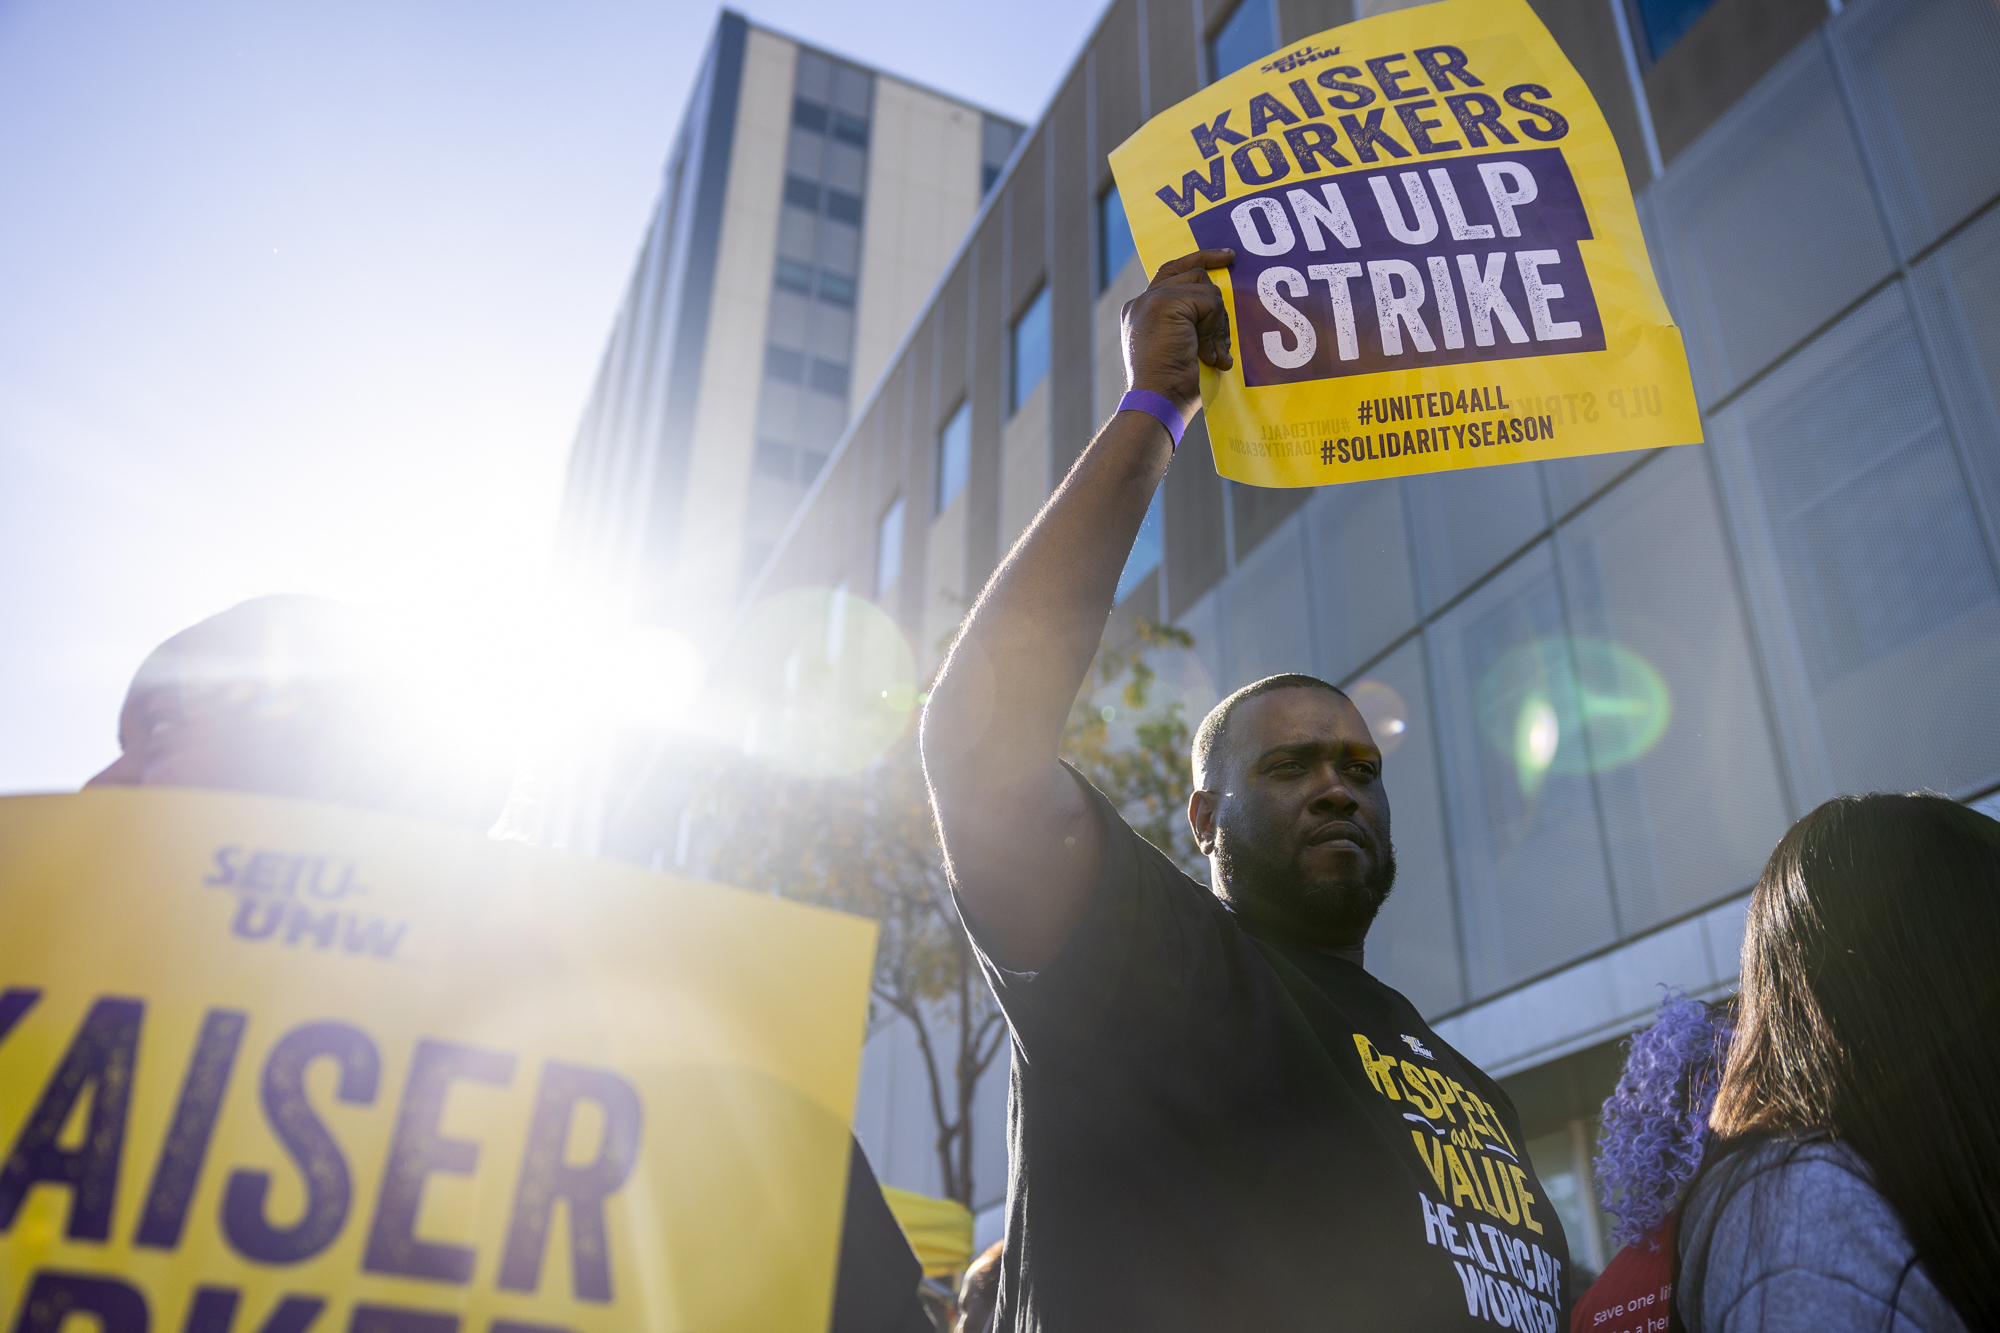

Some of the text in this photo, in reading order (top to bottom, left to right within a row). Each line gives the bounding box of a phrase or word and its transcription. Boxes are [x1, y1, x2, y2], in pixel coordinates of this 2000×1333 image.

[1260, 46, 1320, 74] SEIU-
[1279, 46, 1341, 73] UHW
[1190, 44, 1487, 159] KAISER
[1154, 82, 1570, 218] WORKERS
[1229, 160, 1540, 257] ON ULP
[1256, 248, 1584, 370] STRIKE
[1357, 385, 1510, 426] #UNITED4ALL
[1320, 414, 1554, 466] #SOLIDARITYSEASON
[203, 845, 370, 904] SEIU-
[229, 895, 409, 959] UHW
[0, 985, 643, 1305] AISER
[1450, 1122, 1484, 1150] and
[1411, 1129, 1544, 1236] VALUE
[1593, 1304, 1624, 1327] save
[1627, 1293, 1656, 1312] one
